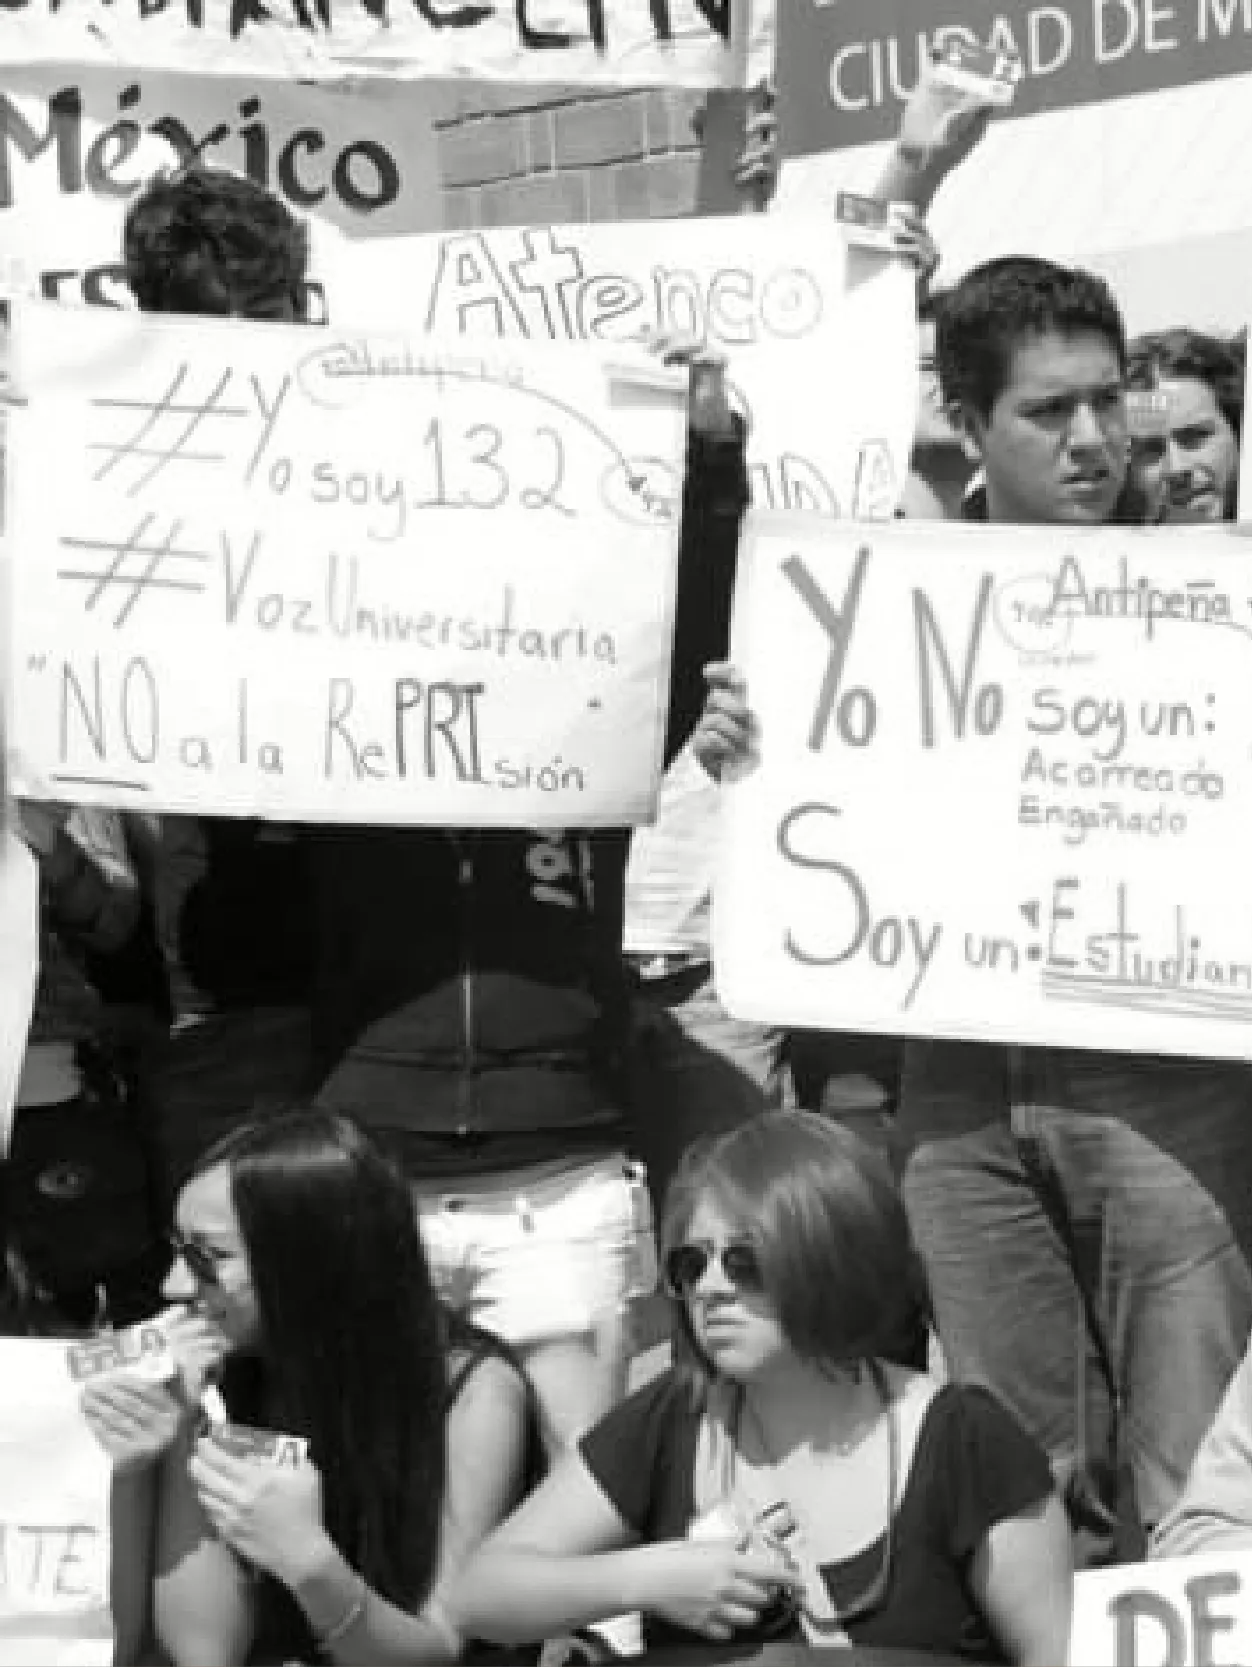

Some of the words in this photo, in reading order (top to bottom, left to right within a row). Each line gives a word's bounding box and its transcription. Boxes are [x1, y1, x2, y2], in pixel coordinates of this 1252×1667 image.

[1094, 0, 1178, 63] DE
[0, 84, 400, 212] México
[424, 226, 823, 345] Atenco
[780, 546, 877, 752] Yo
[911, 572, 1003, 749] No
[776, 801, 942, 1010] Soy
